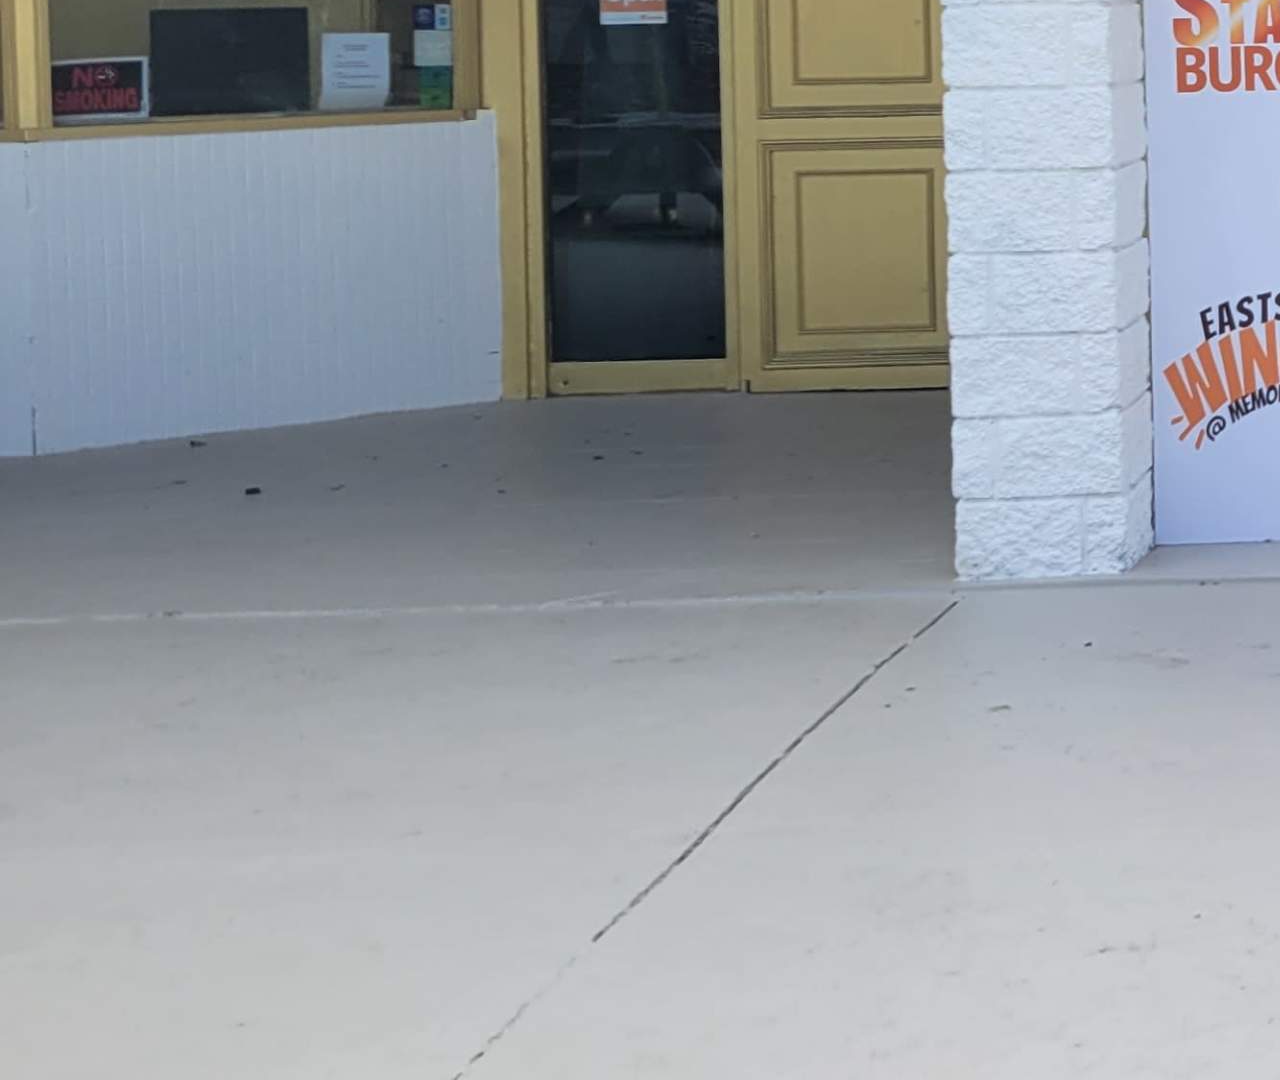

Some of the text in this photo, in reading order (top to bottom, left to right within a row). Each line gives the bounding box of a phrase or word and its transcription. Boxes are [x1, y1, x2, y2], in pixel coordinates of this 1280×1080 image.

[71, 66, 117, 89] NO
[54, 88, 138, 111] SMOKING
[1206, 415, 1227, 441] @
